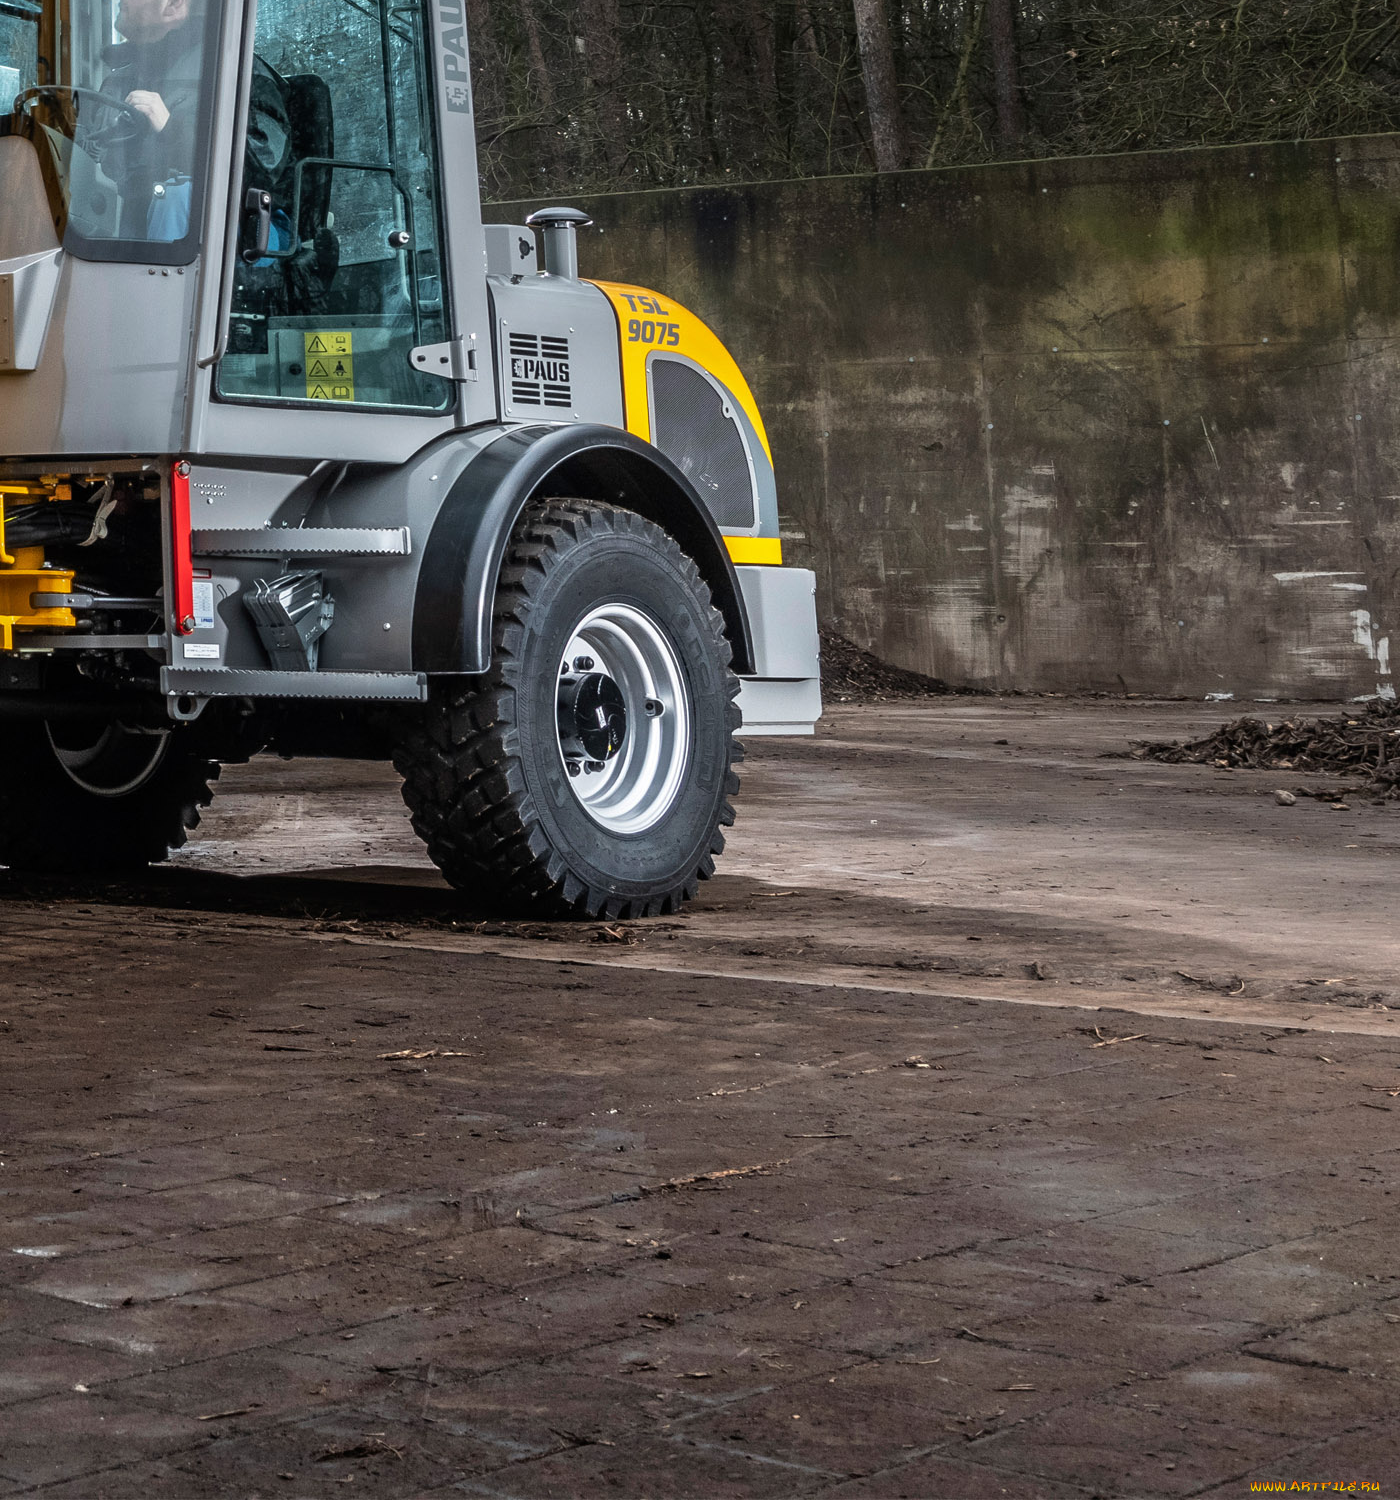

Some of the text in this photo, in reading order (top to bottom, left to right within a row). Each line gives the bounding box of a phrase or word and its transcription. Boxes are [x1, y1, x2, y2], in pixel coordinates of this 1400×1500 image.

[619, 293, 669, 316] TSL
[628, 319, 680, 346] 9075
[523, 359, 570, 382] PAUS
